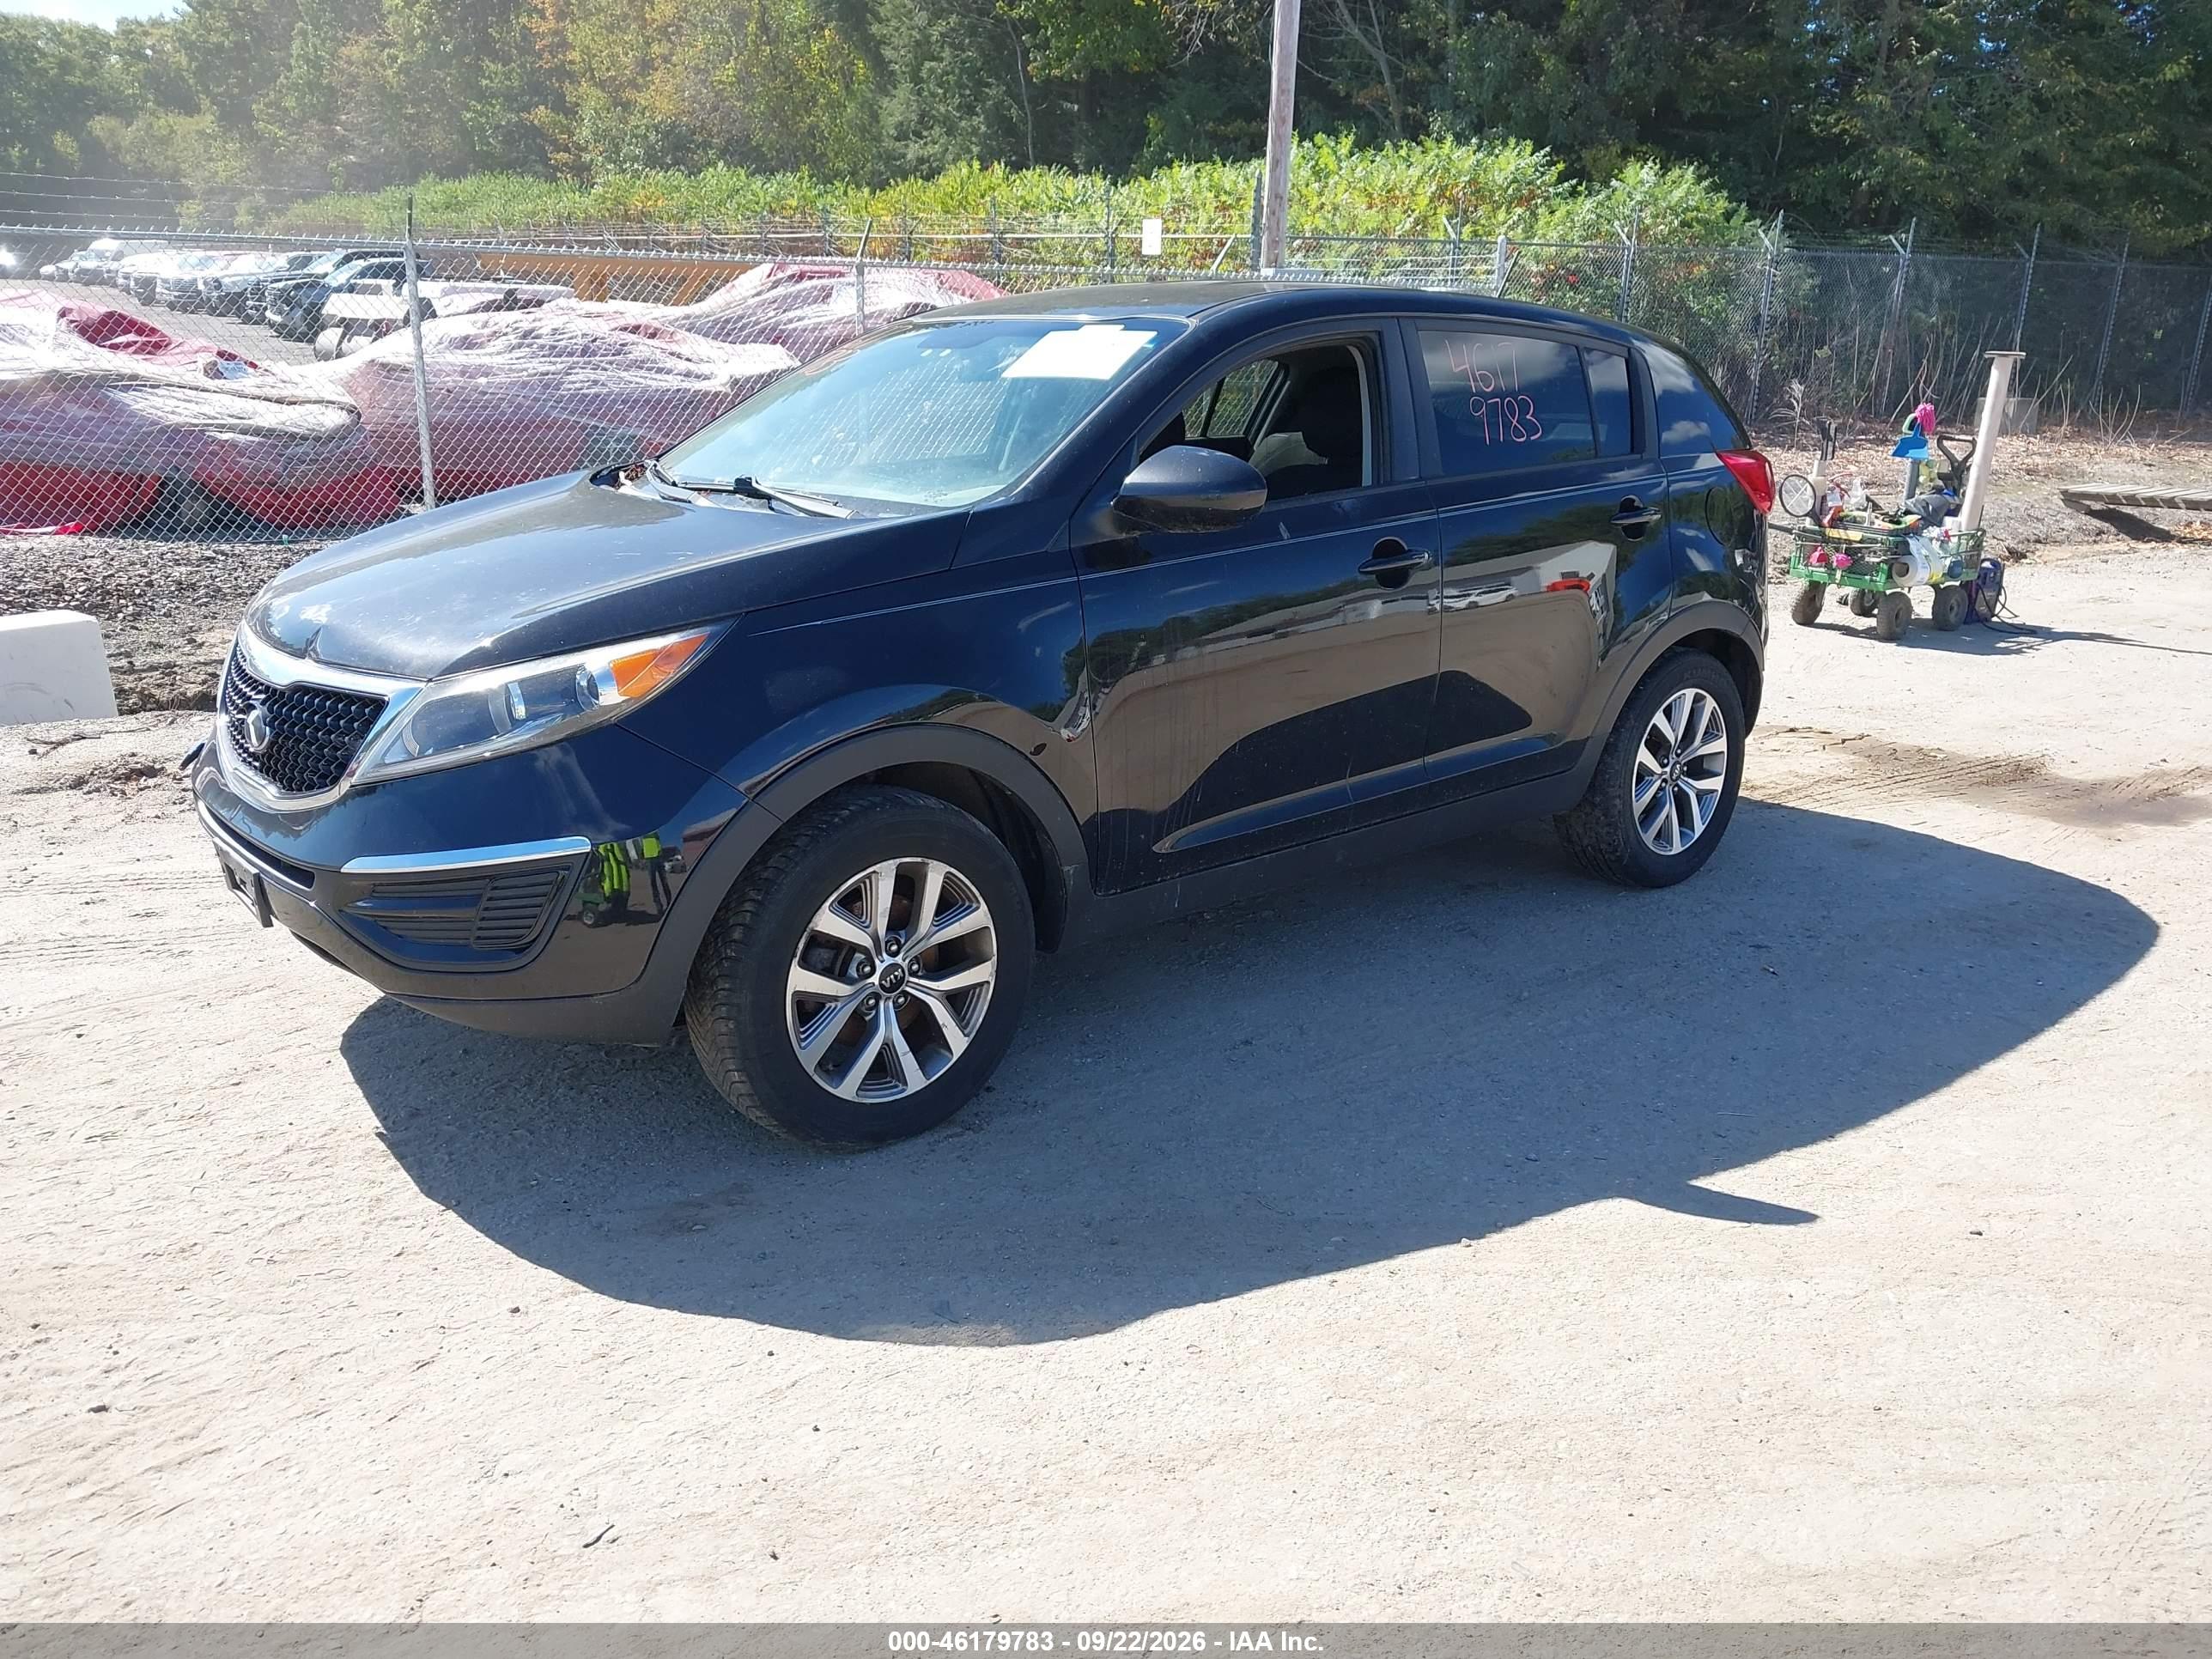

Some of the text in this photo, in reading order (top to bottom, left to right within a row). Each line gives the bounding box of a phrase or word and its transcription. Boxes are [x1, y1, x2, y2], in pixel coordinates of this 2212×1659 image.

[1444, 340, 1518, 393] 4617
[1469, 395, 1542, 446] 9783
[881, 968, 903, 988] KIA
